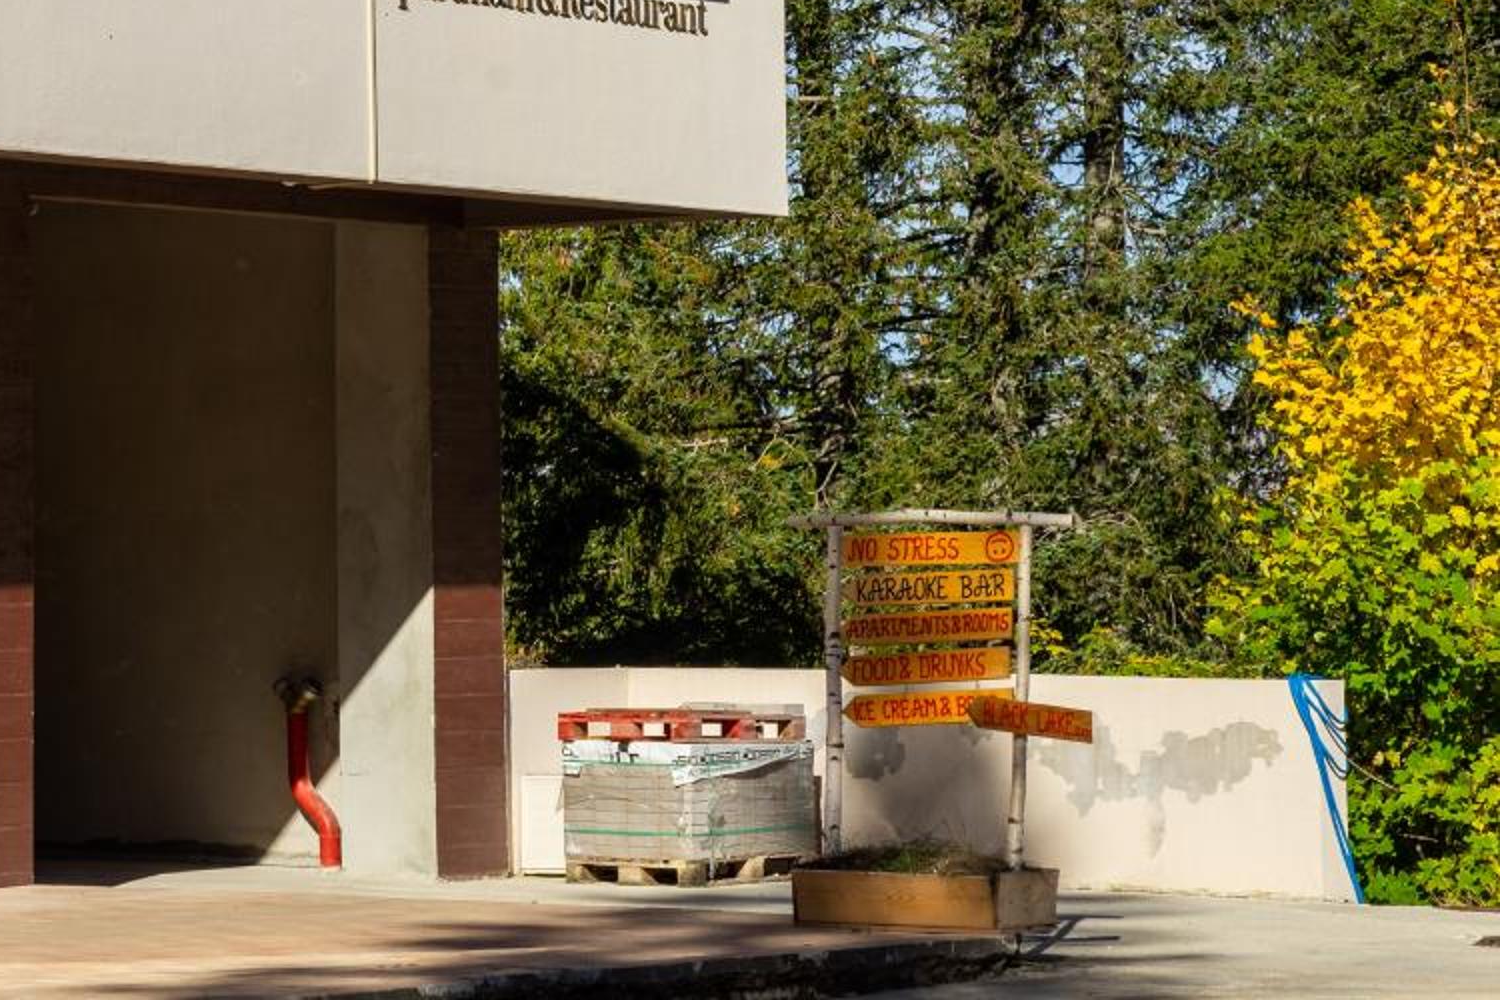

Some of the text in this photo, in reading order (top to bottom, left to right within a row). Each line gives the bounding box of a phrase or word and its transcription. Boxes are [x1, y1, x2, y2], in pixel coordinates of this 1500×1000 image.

[847, 536, 960, 561] NO STRESS
[855, 572, 1006, 602] KARAOKE BAR
